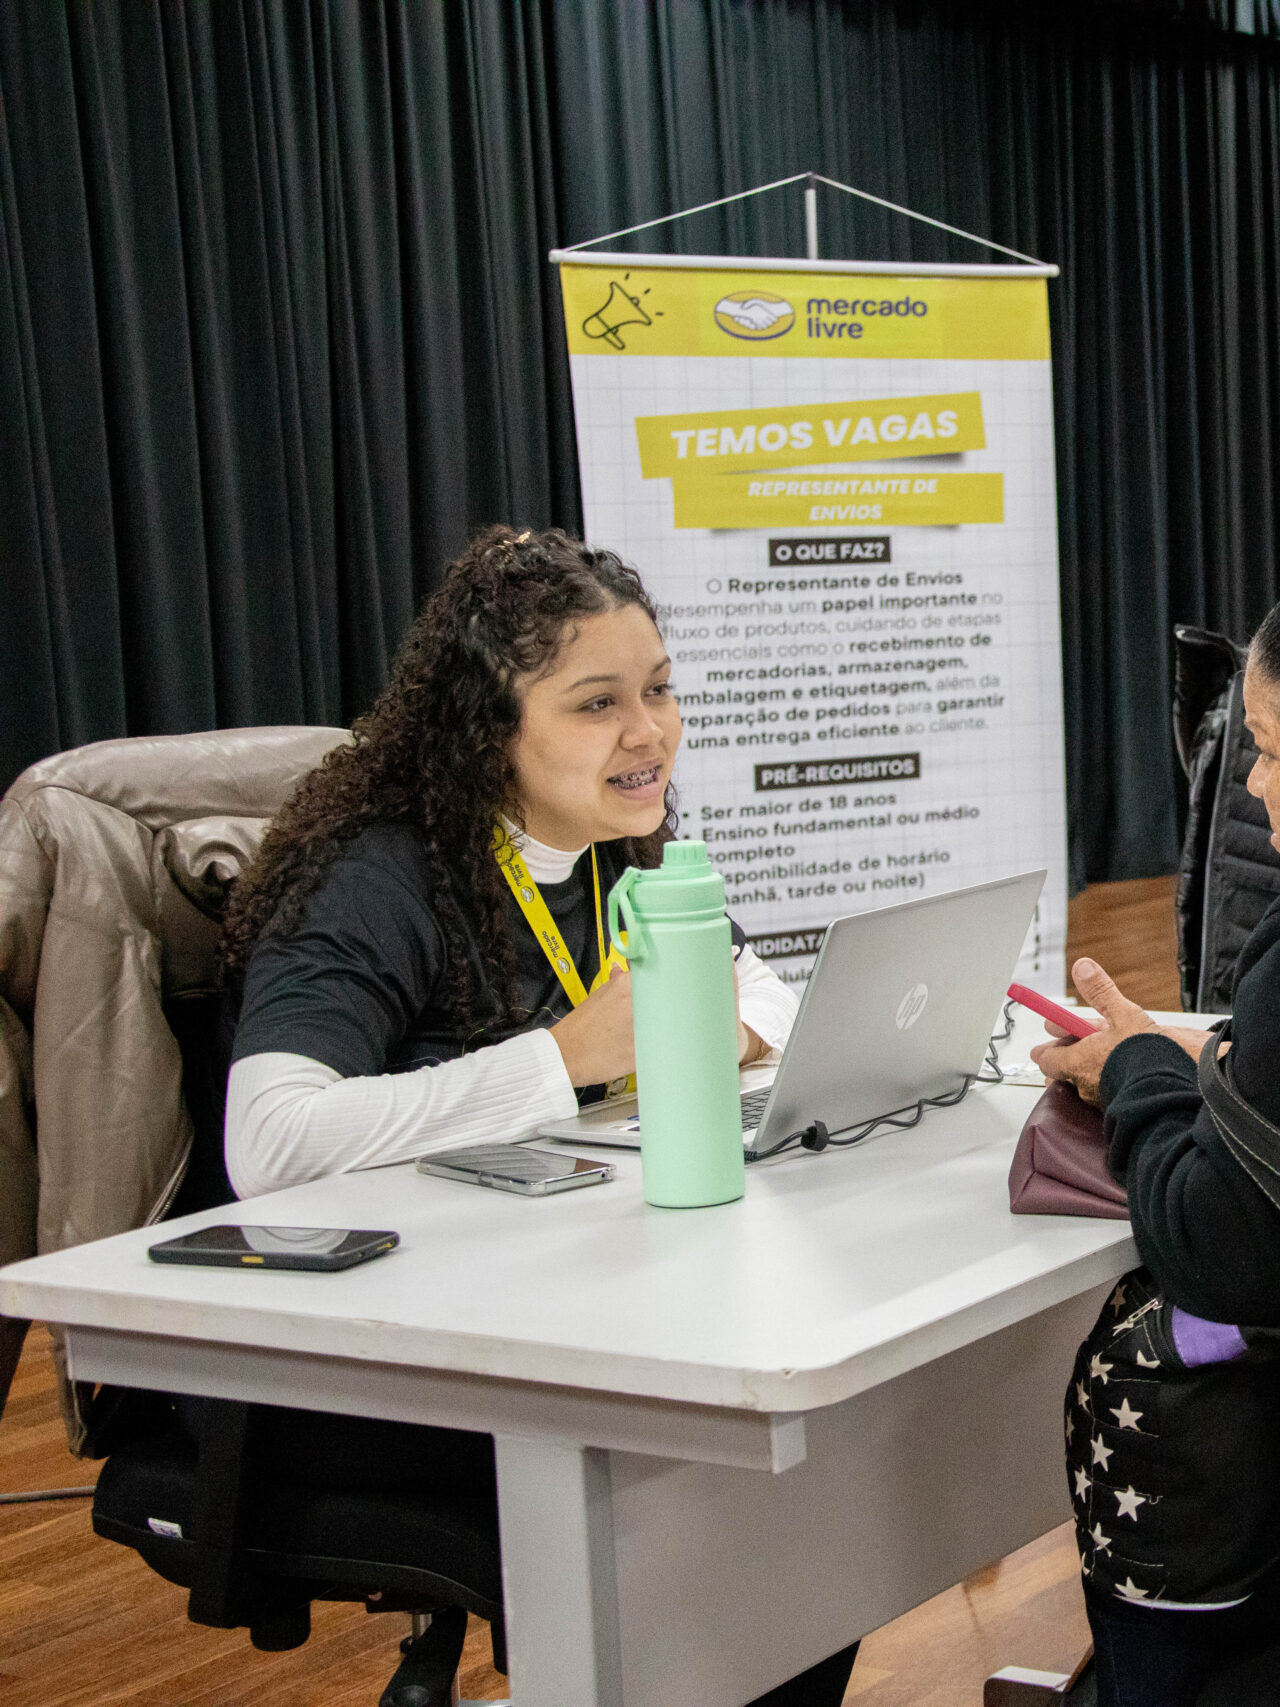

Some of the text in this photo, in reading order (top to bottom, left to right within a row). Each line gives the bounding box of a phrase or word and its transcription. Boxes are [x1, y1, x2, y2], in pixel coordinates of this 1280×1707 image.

[806, 296, 928, 318] mercado
[807, 317, 864, 340] livre
[670, 410, 959, 459] TEMOS VAGAS
[748, 479, 938, 498] REPRESENTANTE DE
[809, 504, 882, 522] ENVIOS
[775, 541, 885, 561] O QUE FAZ?
[706, 571, 963, 596] O Representante de Envios
[787, 599, 817, 614] um
[821, 596, 874, 614] papel
[879, 592, 977, 611] importante
[981, 591, 1003, 606] no
[715, 623, 739, 638] de
[745, 619, 831, 639] produtos,
[836, 616, 916, 633] cuidando
[922, 613, 943, 629] de
[947, 611, 1001, 631] etapas
[676, 633, 991, 662] essenciais como o recebimento de
[707, 658, 968, 682] mercadorias, armazenagem,
[676, 674, 1000, 708] embalagem e etiquetagem, além da
[680, 694, 1005, 727] reparação de pedidos para garantir
[687, 733, 729, 750] uma
[736, 728, 811, 748] entrega
[817, 721, 899, 740] eficiente
[904, 721, 926, 735] ao
[761, 757, 916, 786] PRÉ-REQUISITOS
[701, 793, 898, 822] Ser maior de 18 anos
[702, 803, 980, 842] Ensino fundamental ou médio
[724, 848, 951, 885] sponibilidade de horário
[725, 872, 926, 906] anhã, tarde ou noite)
[542, 930, 558, 958] mercado
